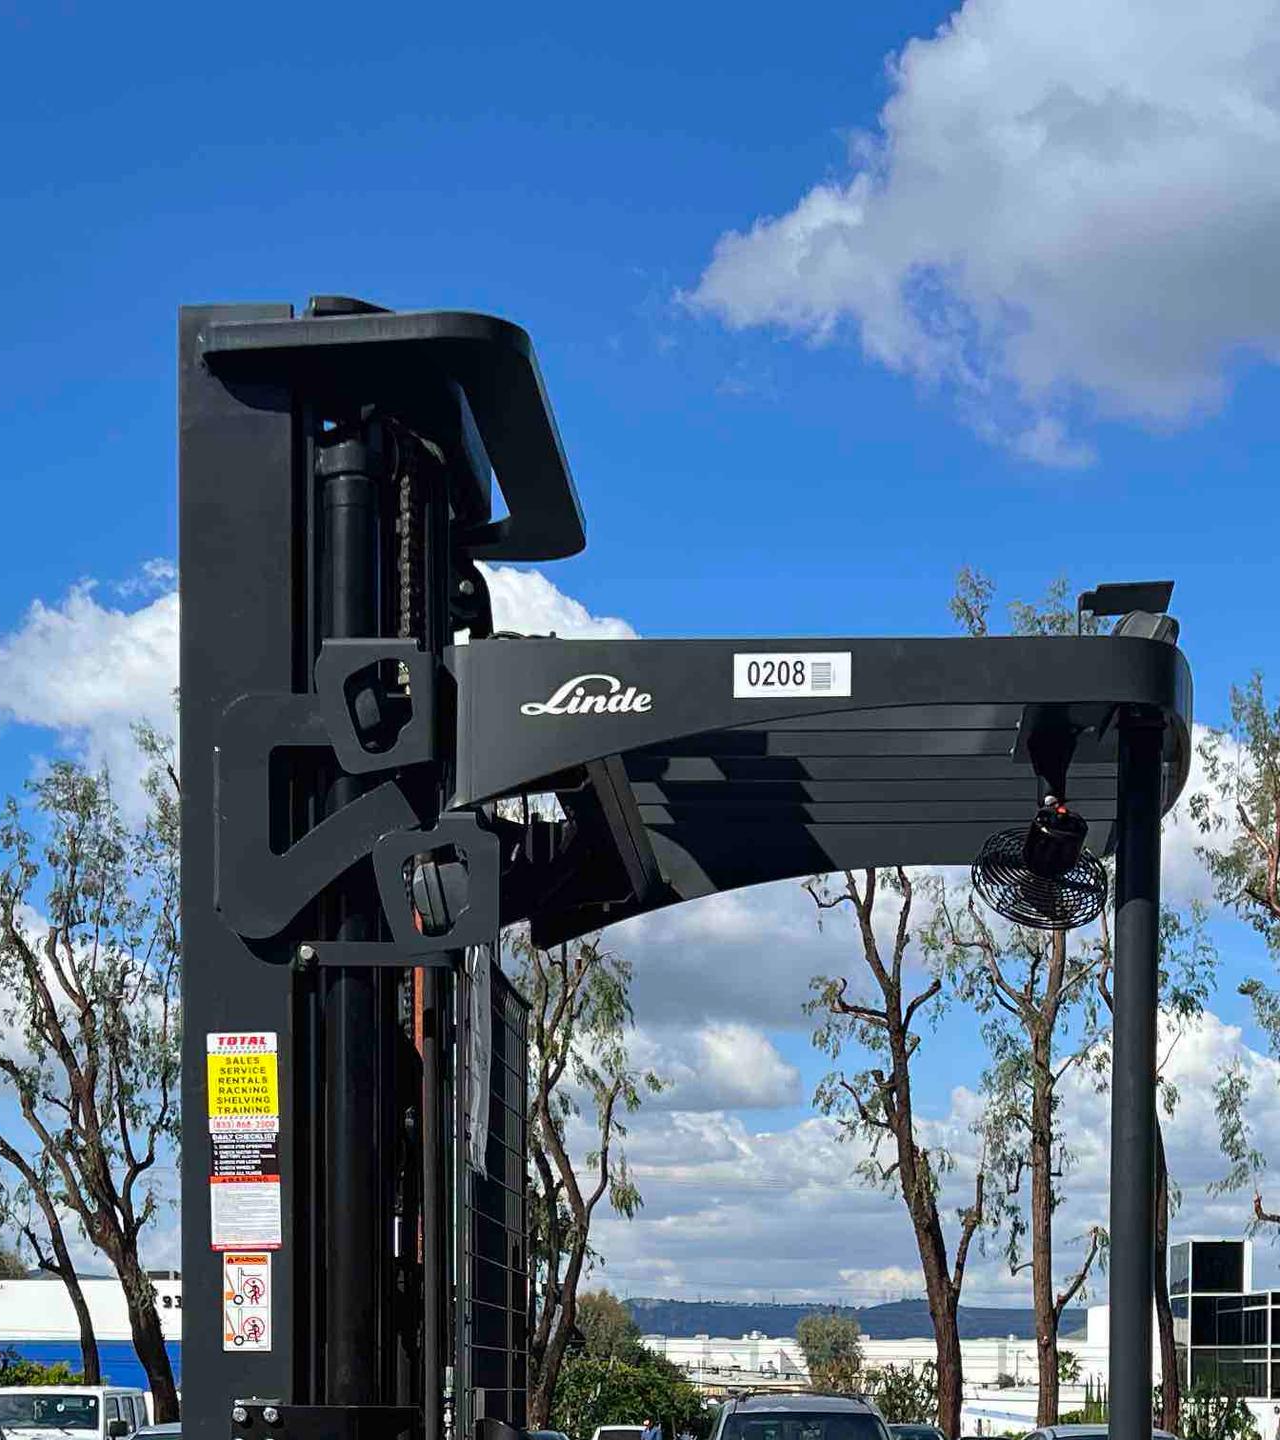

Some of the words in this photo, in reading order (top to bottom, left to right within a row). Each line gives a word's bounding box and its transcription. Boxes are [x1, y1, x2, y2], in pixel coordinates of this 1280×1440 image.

[747, 660, 806, 687] 0208
[520, 674, 652, 715] Linde
[217, 1036, 267, 1046] TOTAL
[225, 1057, 260, 1065] SALES
[220, 1067, 266, 1075] SERVICE
[218, 1077, 268, 1085] RENTALS
[218, 1086, 268, 1095] RACKING
[216, 1096, 271, 1105] SHELVING
[216, 1106, 271, 1115] TRAINING
